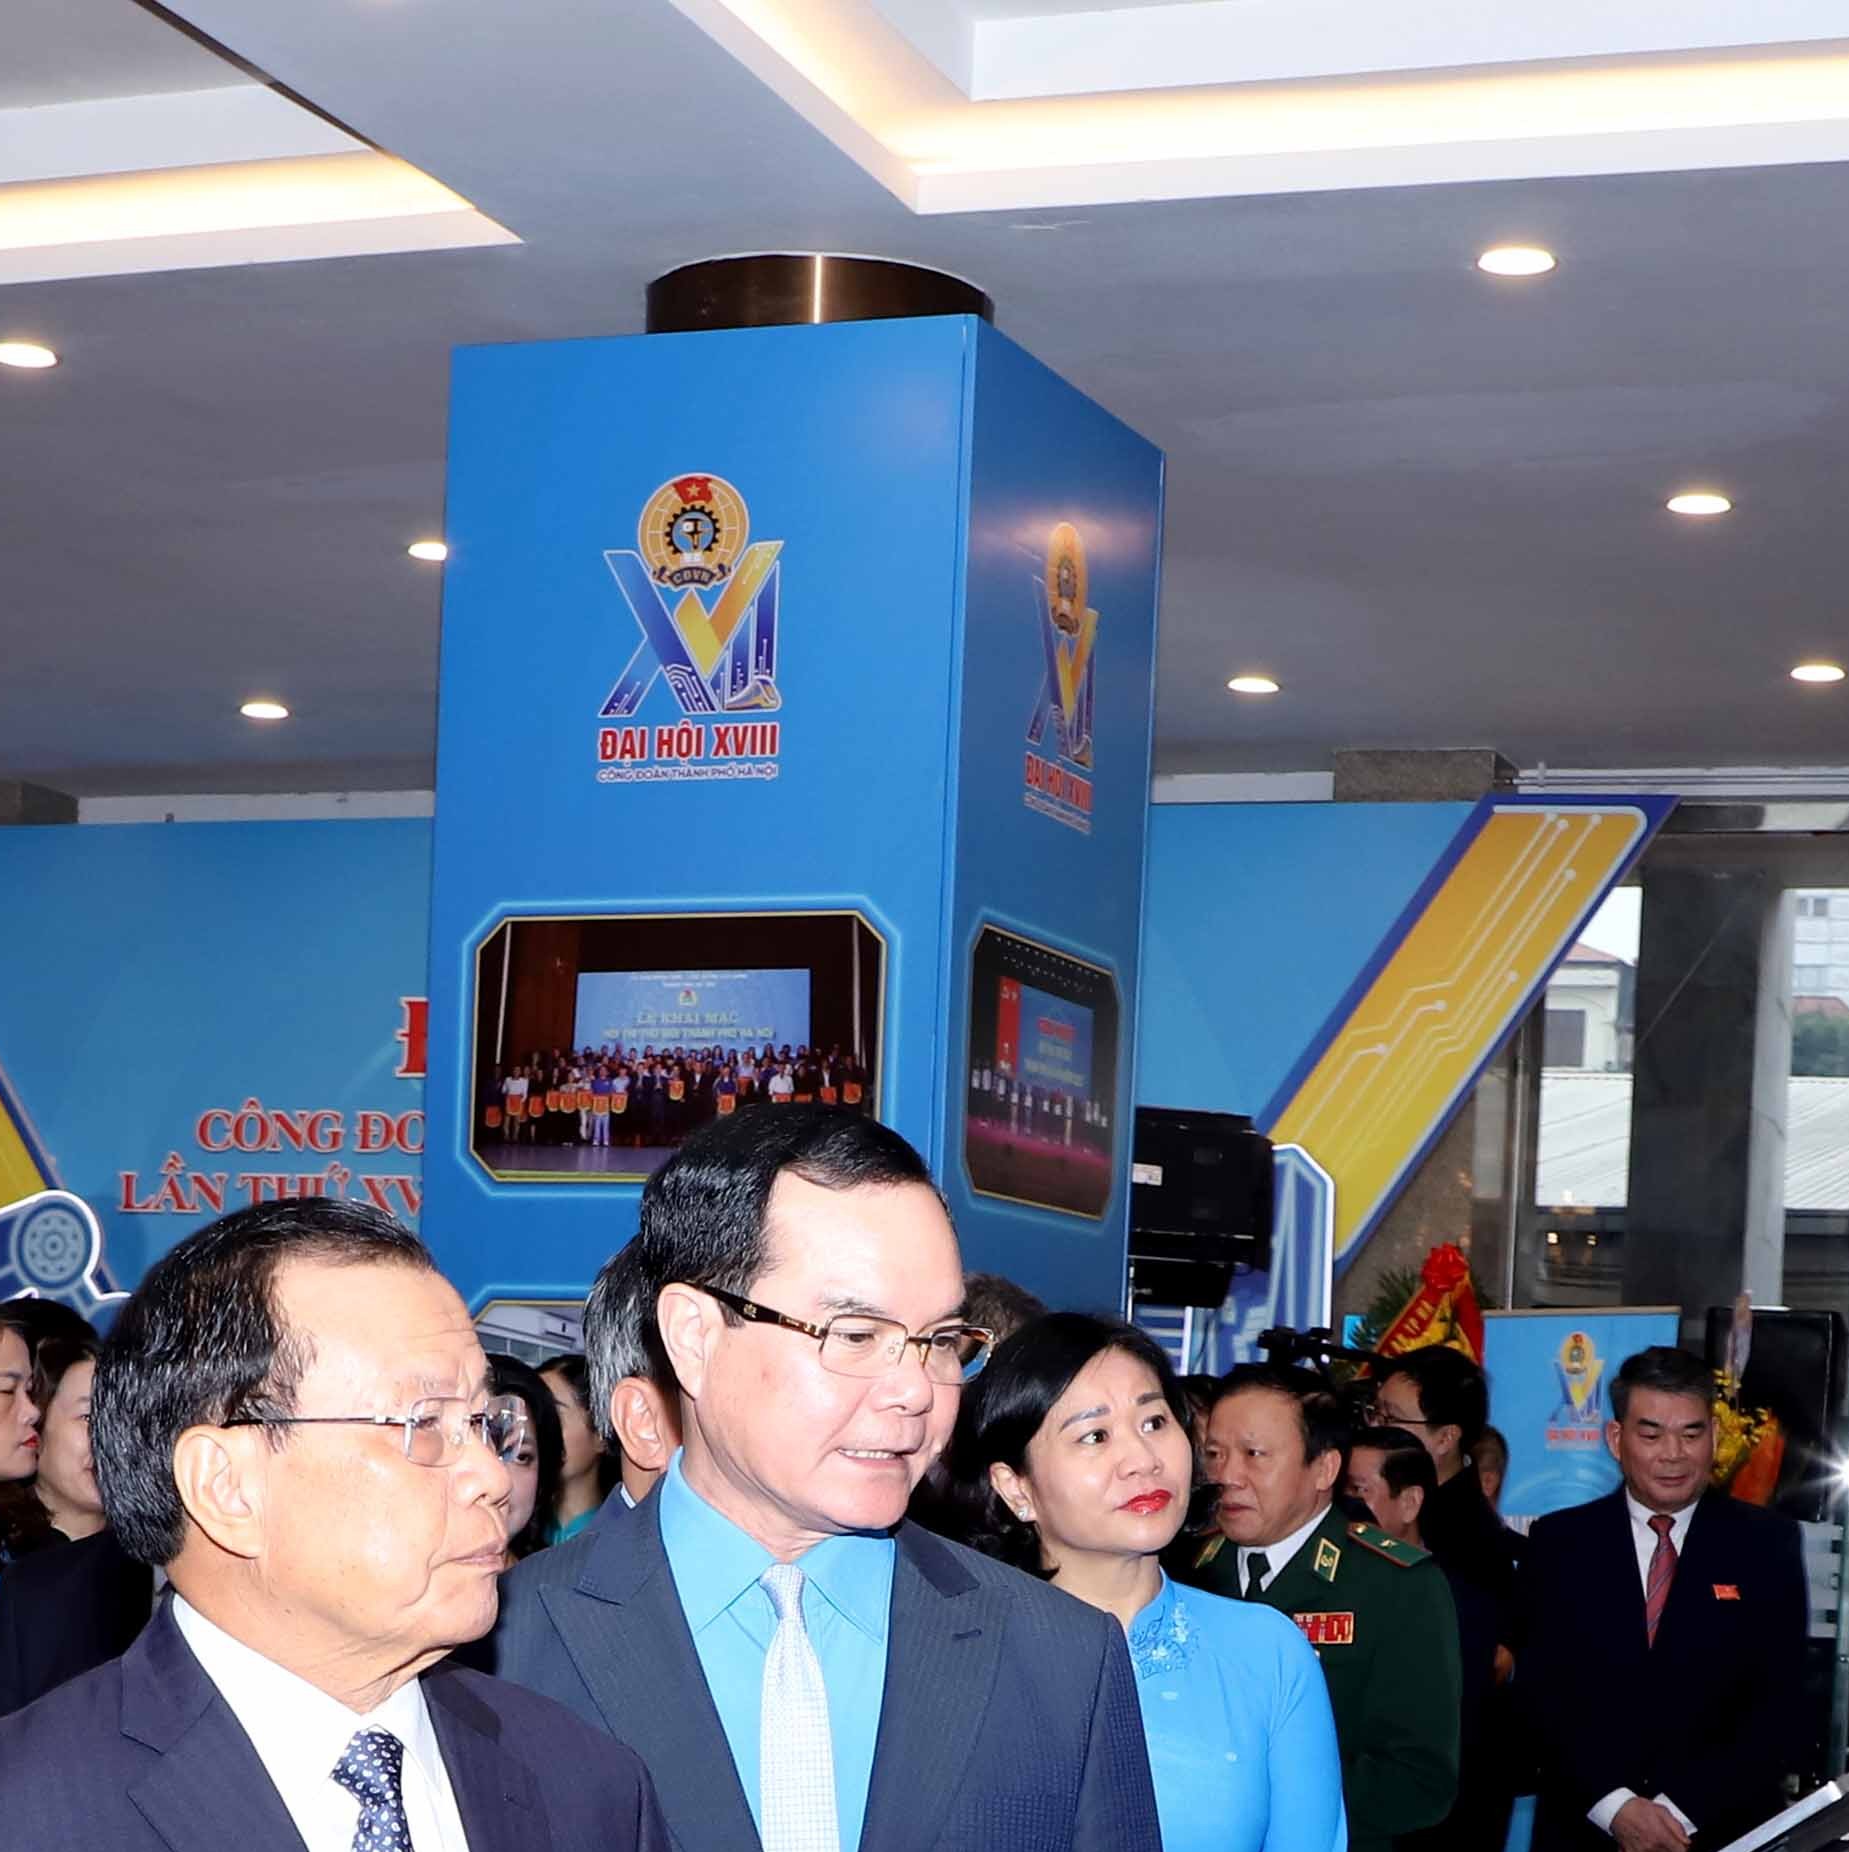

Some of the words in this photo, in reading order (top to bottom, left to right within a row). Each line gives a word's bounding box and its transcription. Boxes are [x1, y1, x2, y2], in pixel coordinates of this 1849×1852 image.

[599, 727, 648, 767] ĐẠI
[655, 718, 704, 766] HỘI
[711, 722, 780, 758] XVIII
[598, 766, 634, 782] CÔNG
[635, 766, 670, 780] ĐOÀN
[671, 765, 709, 779] THÀNH
[711, 763, 736, 778] PHỐ
[737, 763, 756, 776] HÀ
[757, 763, 778, 780] NỘI
[197, 1098, 346, 1152] CÔNG
[356, 1109, 424, 1153] ĐO
[119, 1151, 229, 1214] LẦN
